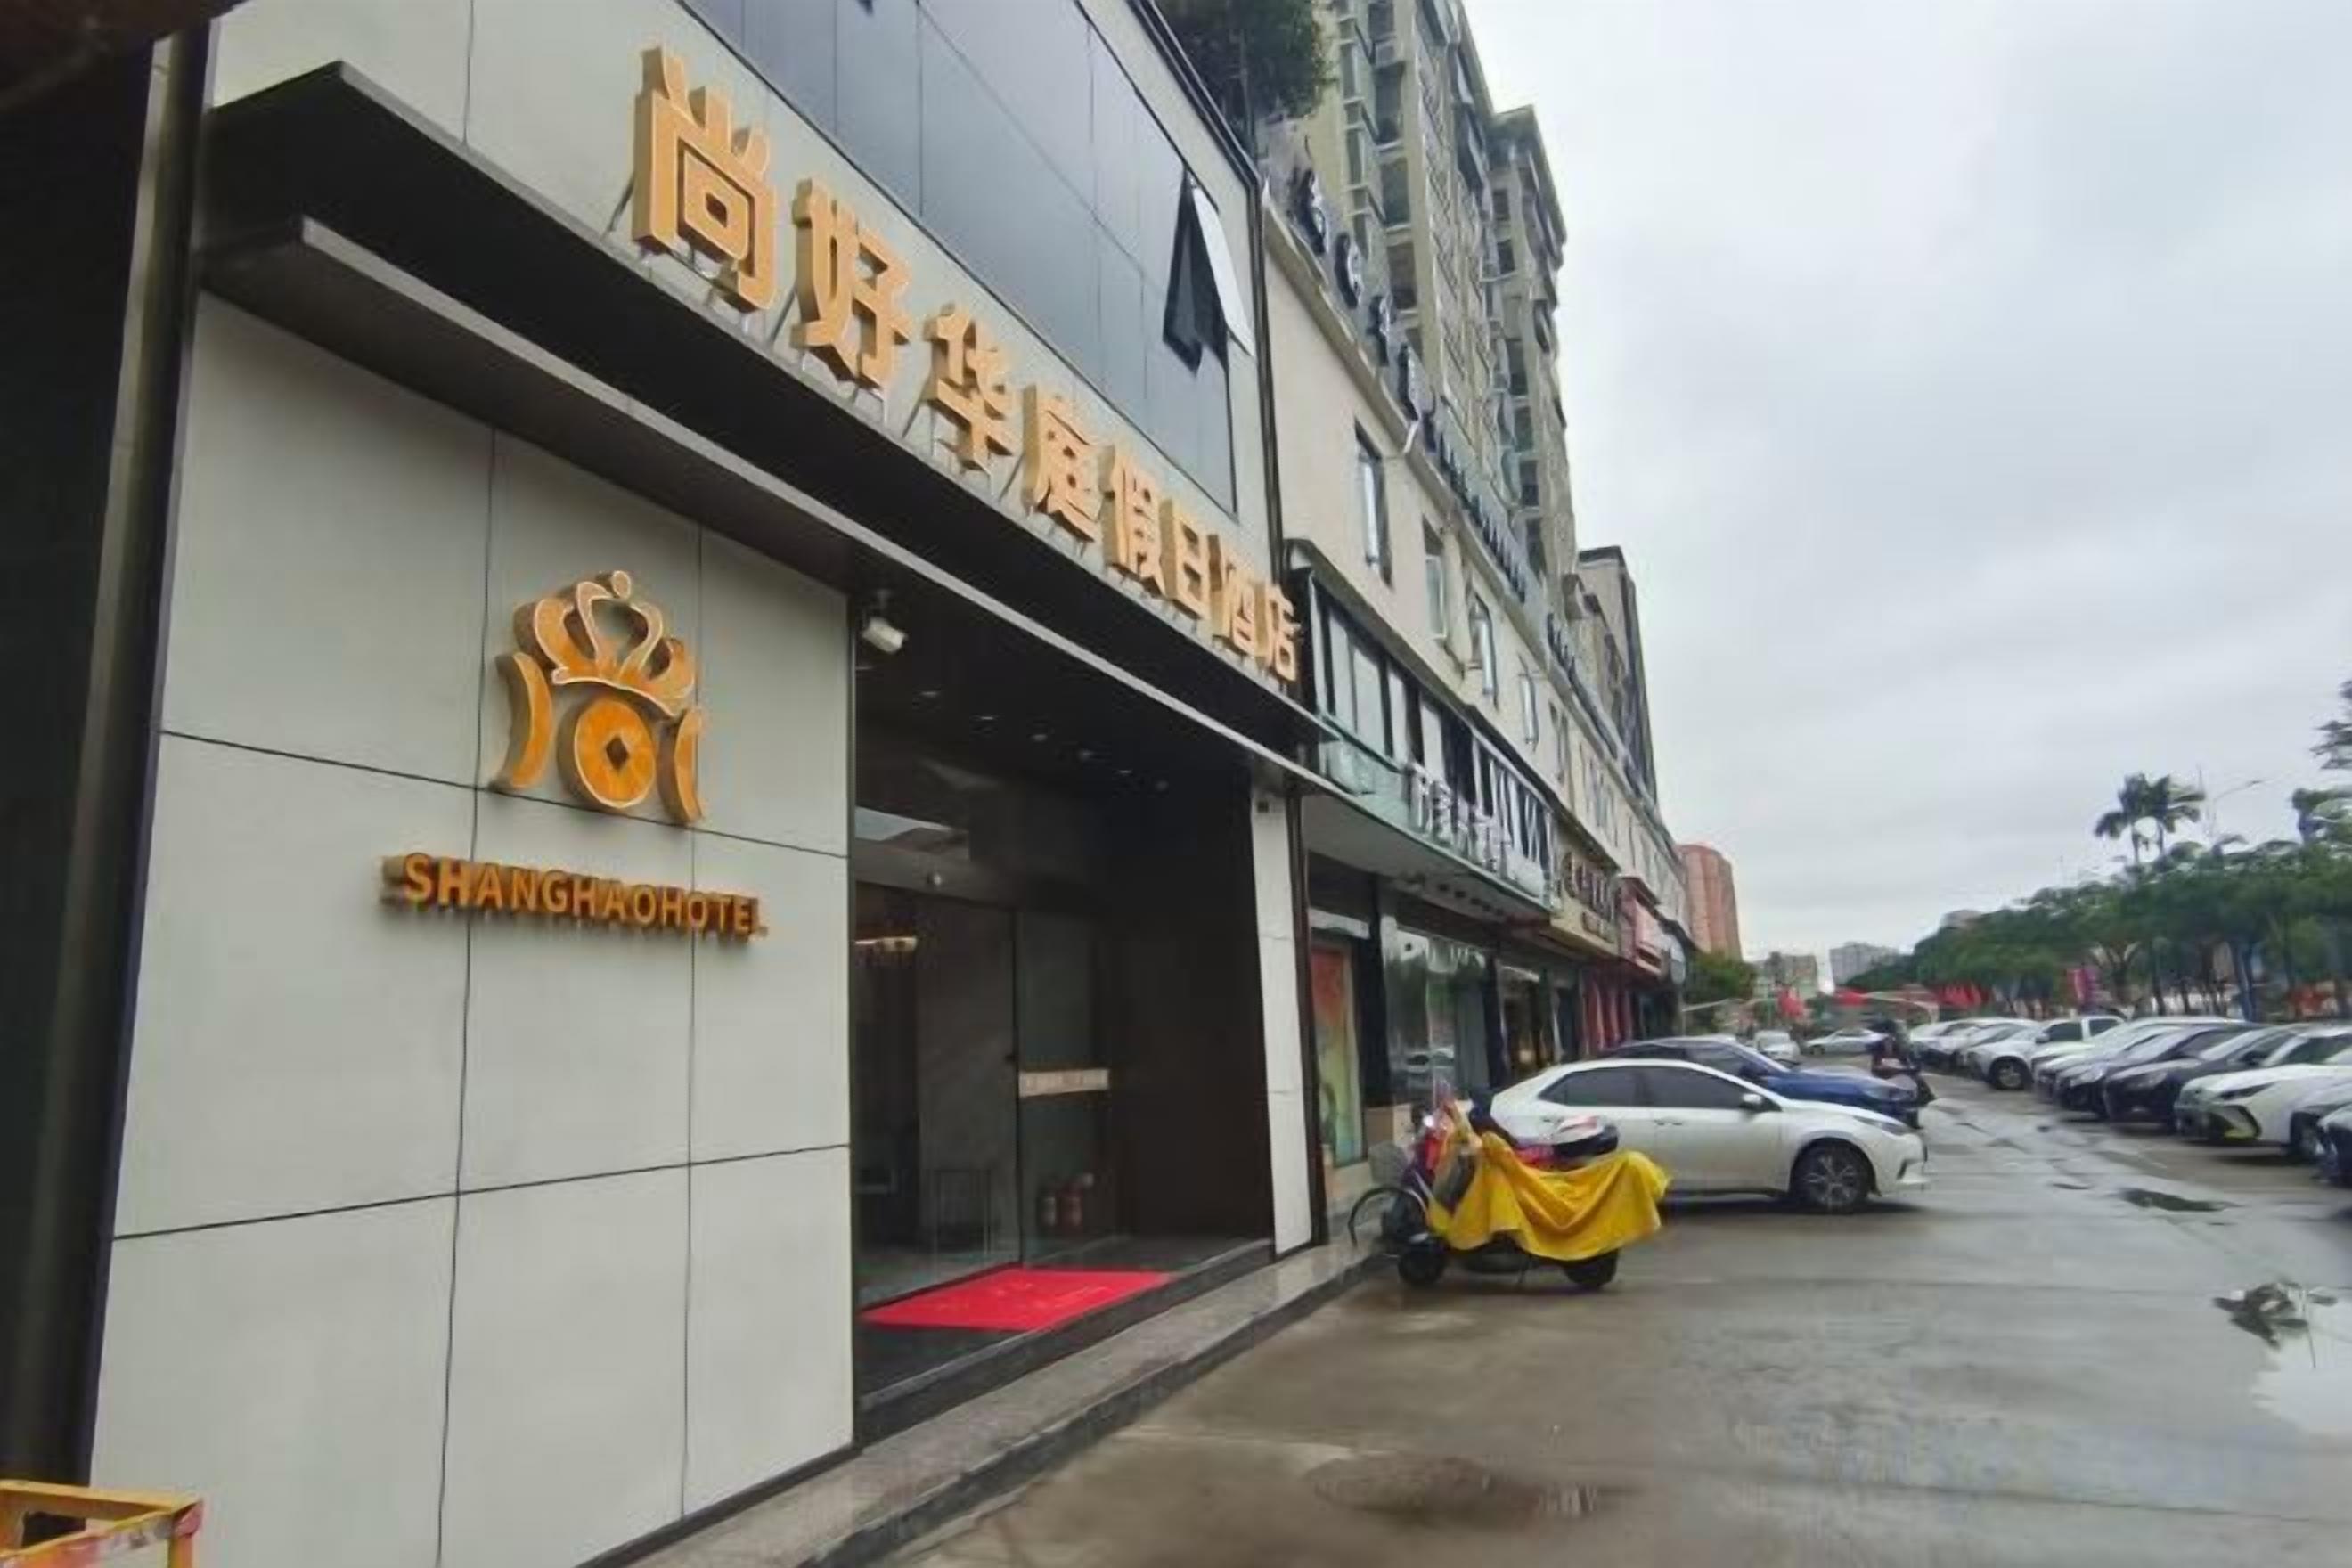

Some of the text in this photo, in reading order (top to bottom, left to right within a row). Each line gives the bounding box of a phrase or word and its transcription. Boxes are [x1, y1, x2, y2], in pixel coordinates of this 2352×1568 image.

[634, 41, 1300, 682] 尚好华庭假日酒店
